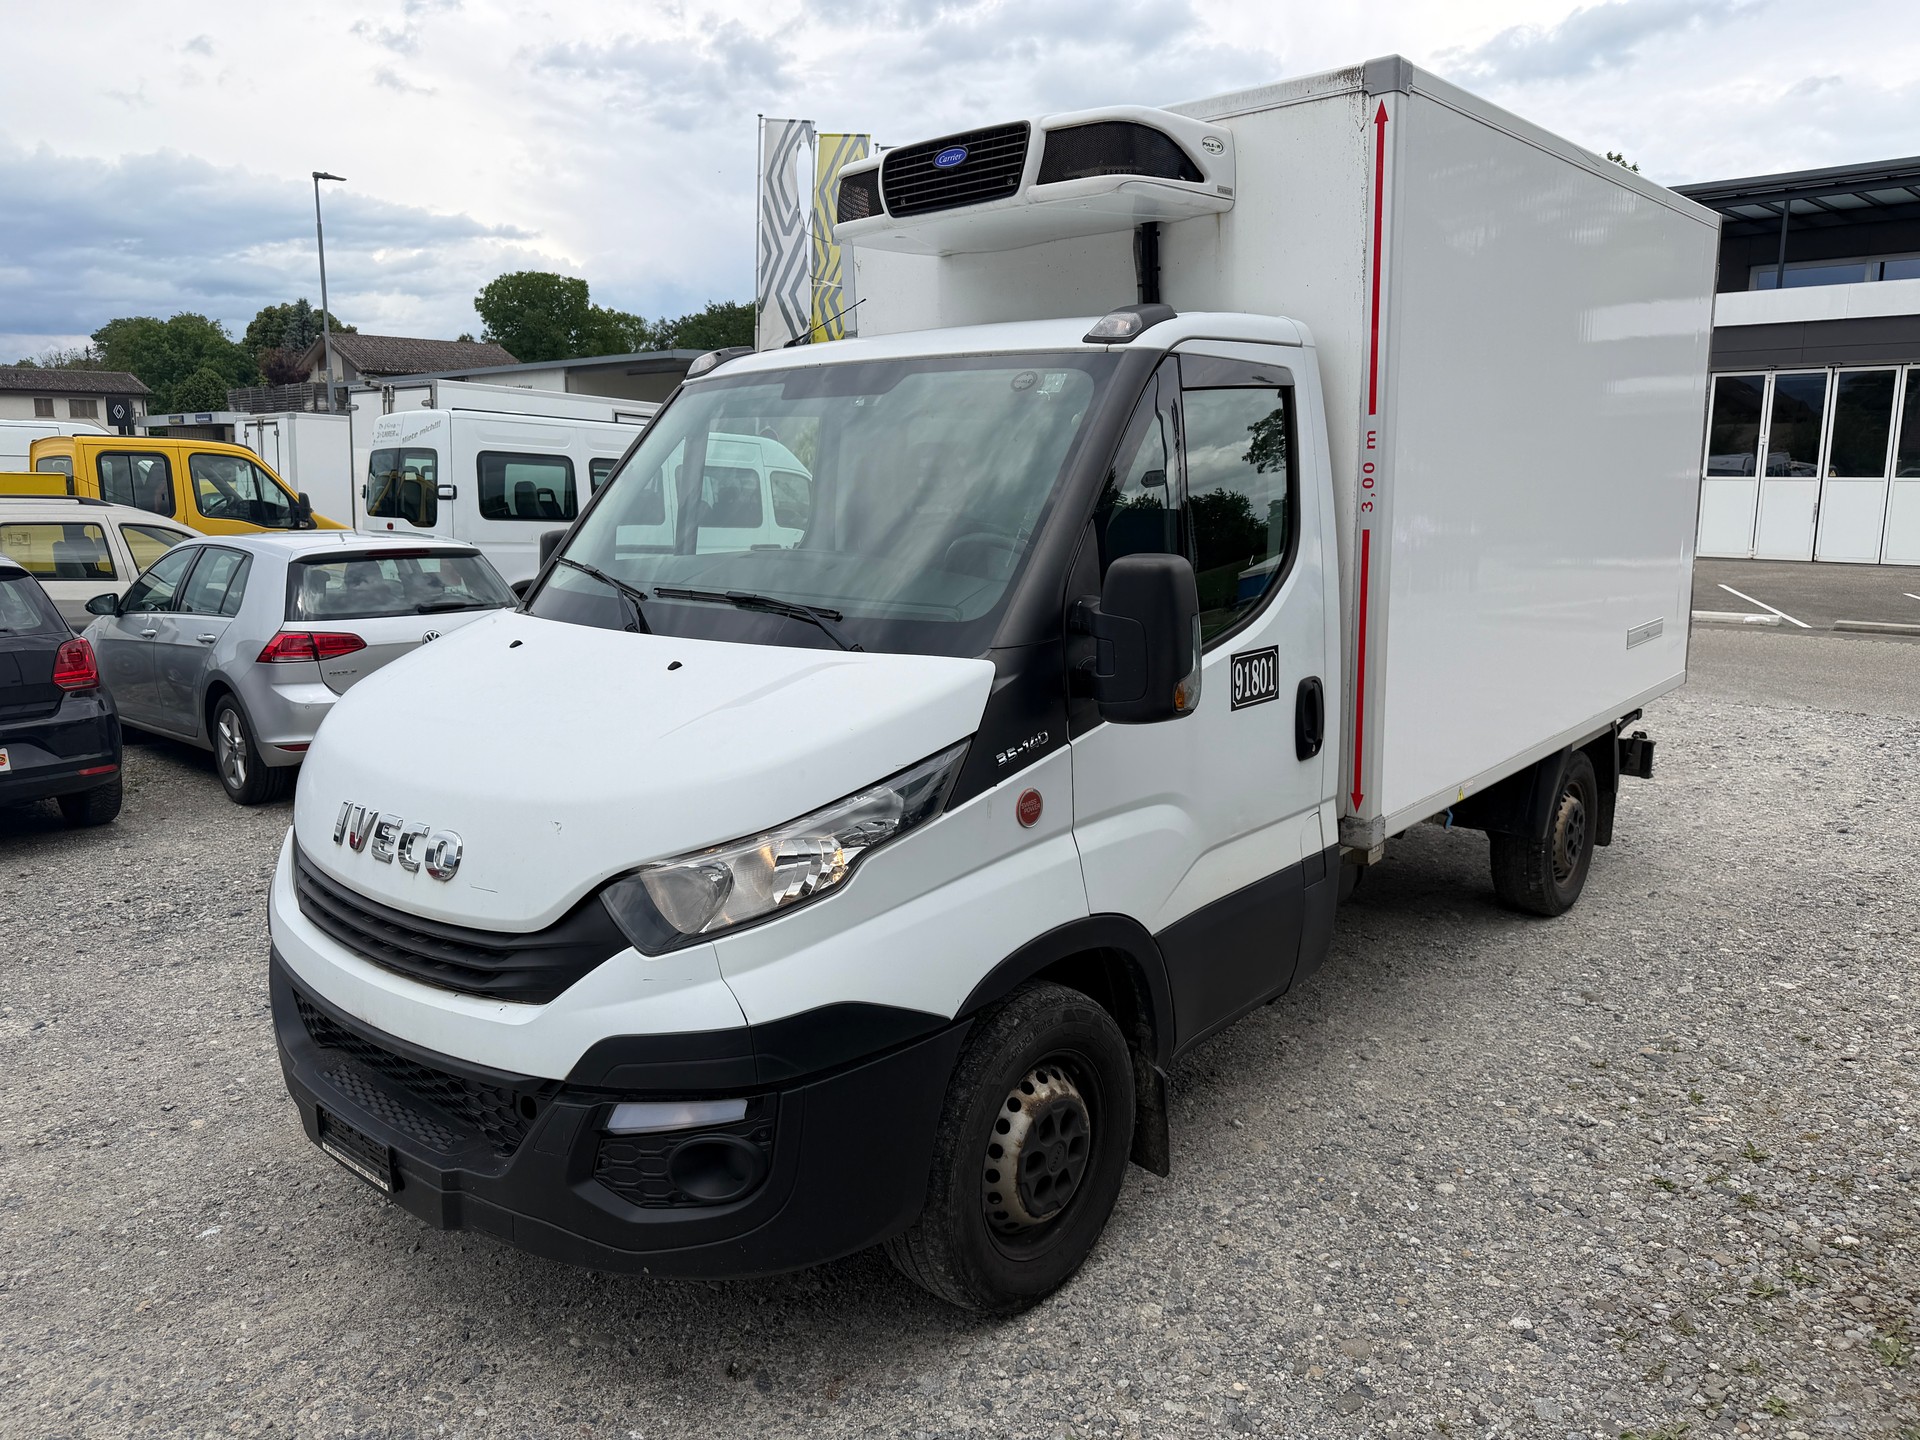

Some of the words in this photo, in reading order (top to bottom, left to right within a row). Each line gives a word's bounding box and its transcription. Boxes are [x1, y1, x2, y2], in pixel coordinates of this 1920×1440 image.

[938, 153, 963, 164] Carrier
[401, 431, 418, 444] Miete
[1366, 430, 1376, 449] m
[1361, 462, 1376, 513] 3,00
[1234, 656, 1275, 700] 91801
[995, 730, 1049, 768] 35-140
[1021, 798, 1037, 810] SWISS
[1024, 803, 1041, 814] POWER
[332, 800, 464, 882] IVECO
[1031, 1016, 1054, 1037] Winter
